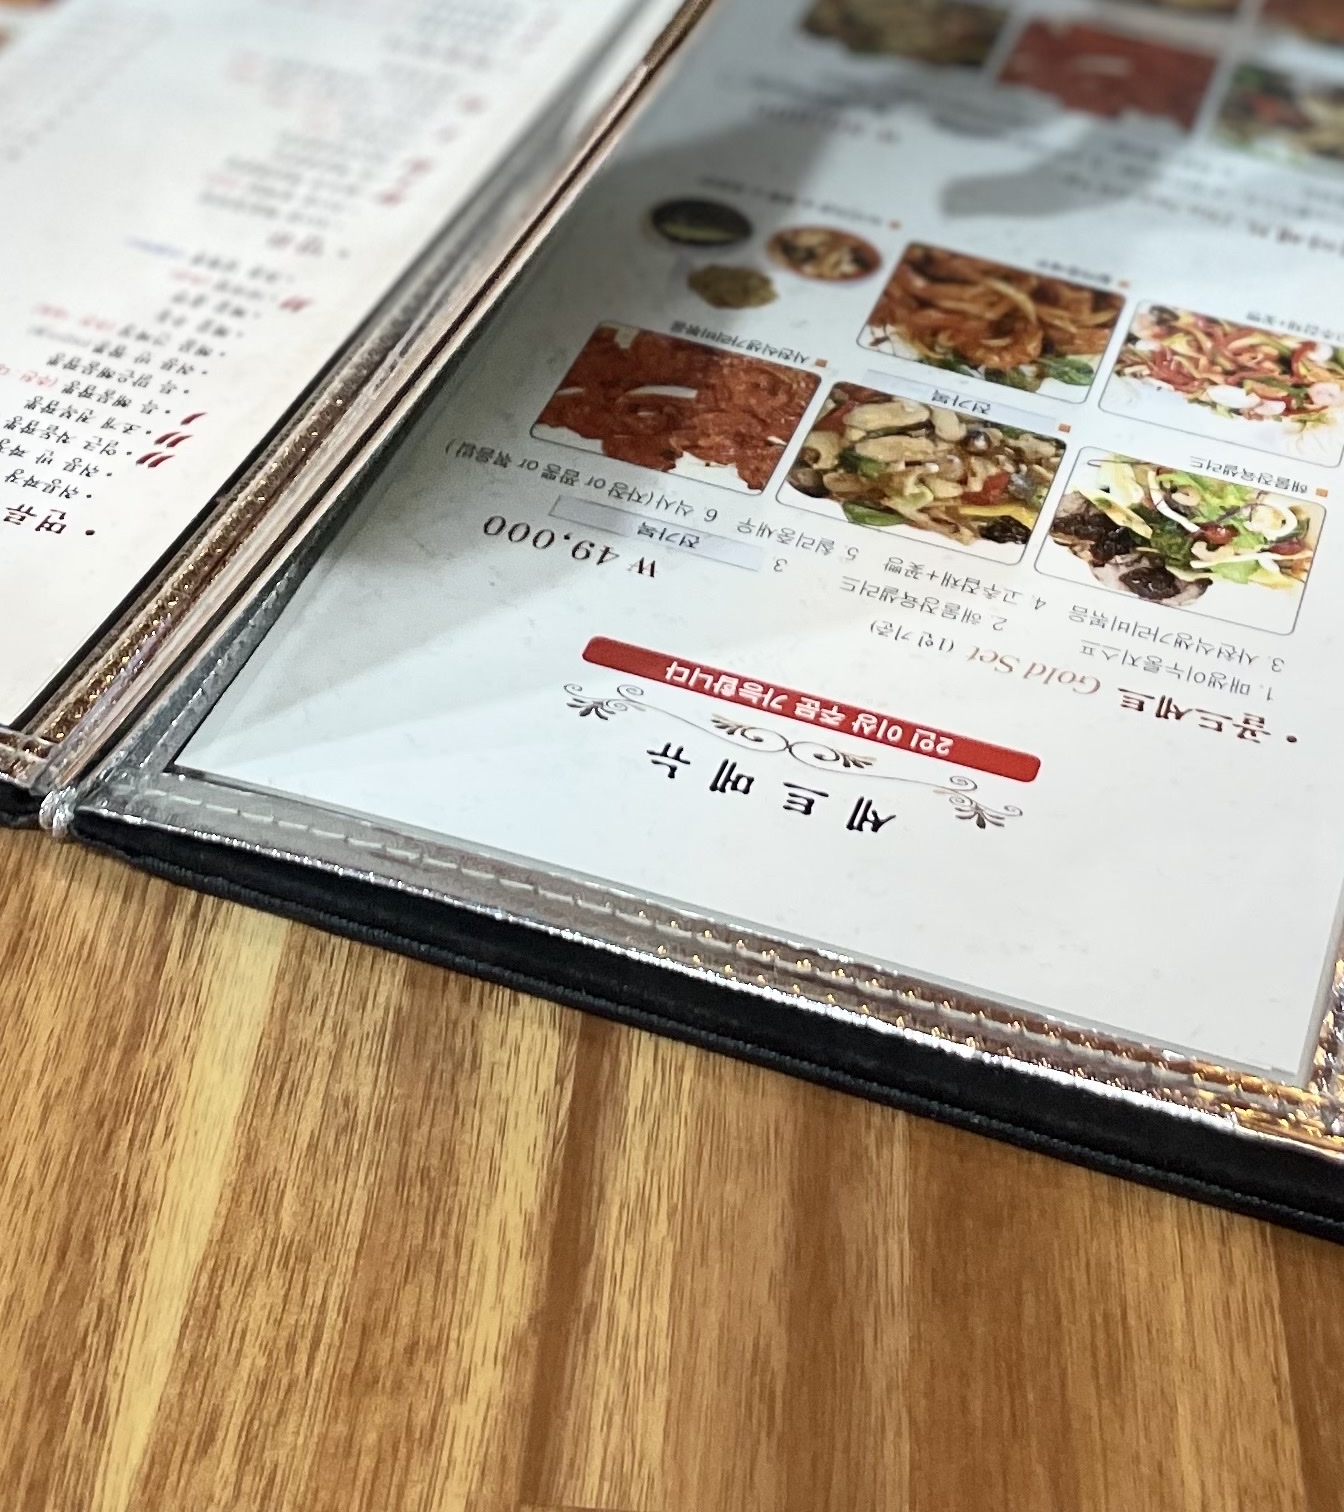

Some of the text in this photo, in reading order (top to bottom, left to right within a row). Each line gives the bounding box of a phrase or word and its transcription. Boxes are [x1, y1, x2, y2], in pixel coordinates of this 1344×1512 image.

[930, 388, 992, 416] 전가복
[35, 450, 54, 465] 반
[516, 458, 538, 472] or
[539, 463, 580, 487] 짬뽕
[585, 476, 606, 490] or
[1189, 456, 1307, 494] 해물장육샐러드
[3, 504, 67, 535] 면류
[636, 521, 700, 549] 전가복
[482, 515, 621, 567] 49,000
[737, 518, 835, 556] 칠리중새우
[839, 575, 982, 626] 해물장육샐러드
[1068, 604, 1260, 664] 사천식생가리비볶음
[869, 620, 1271, 744] 골드세트 Gold Set (1인 기준)
[665, 660, 954, 756] 2인 이상 주문 가능합니다
